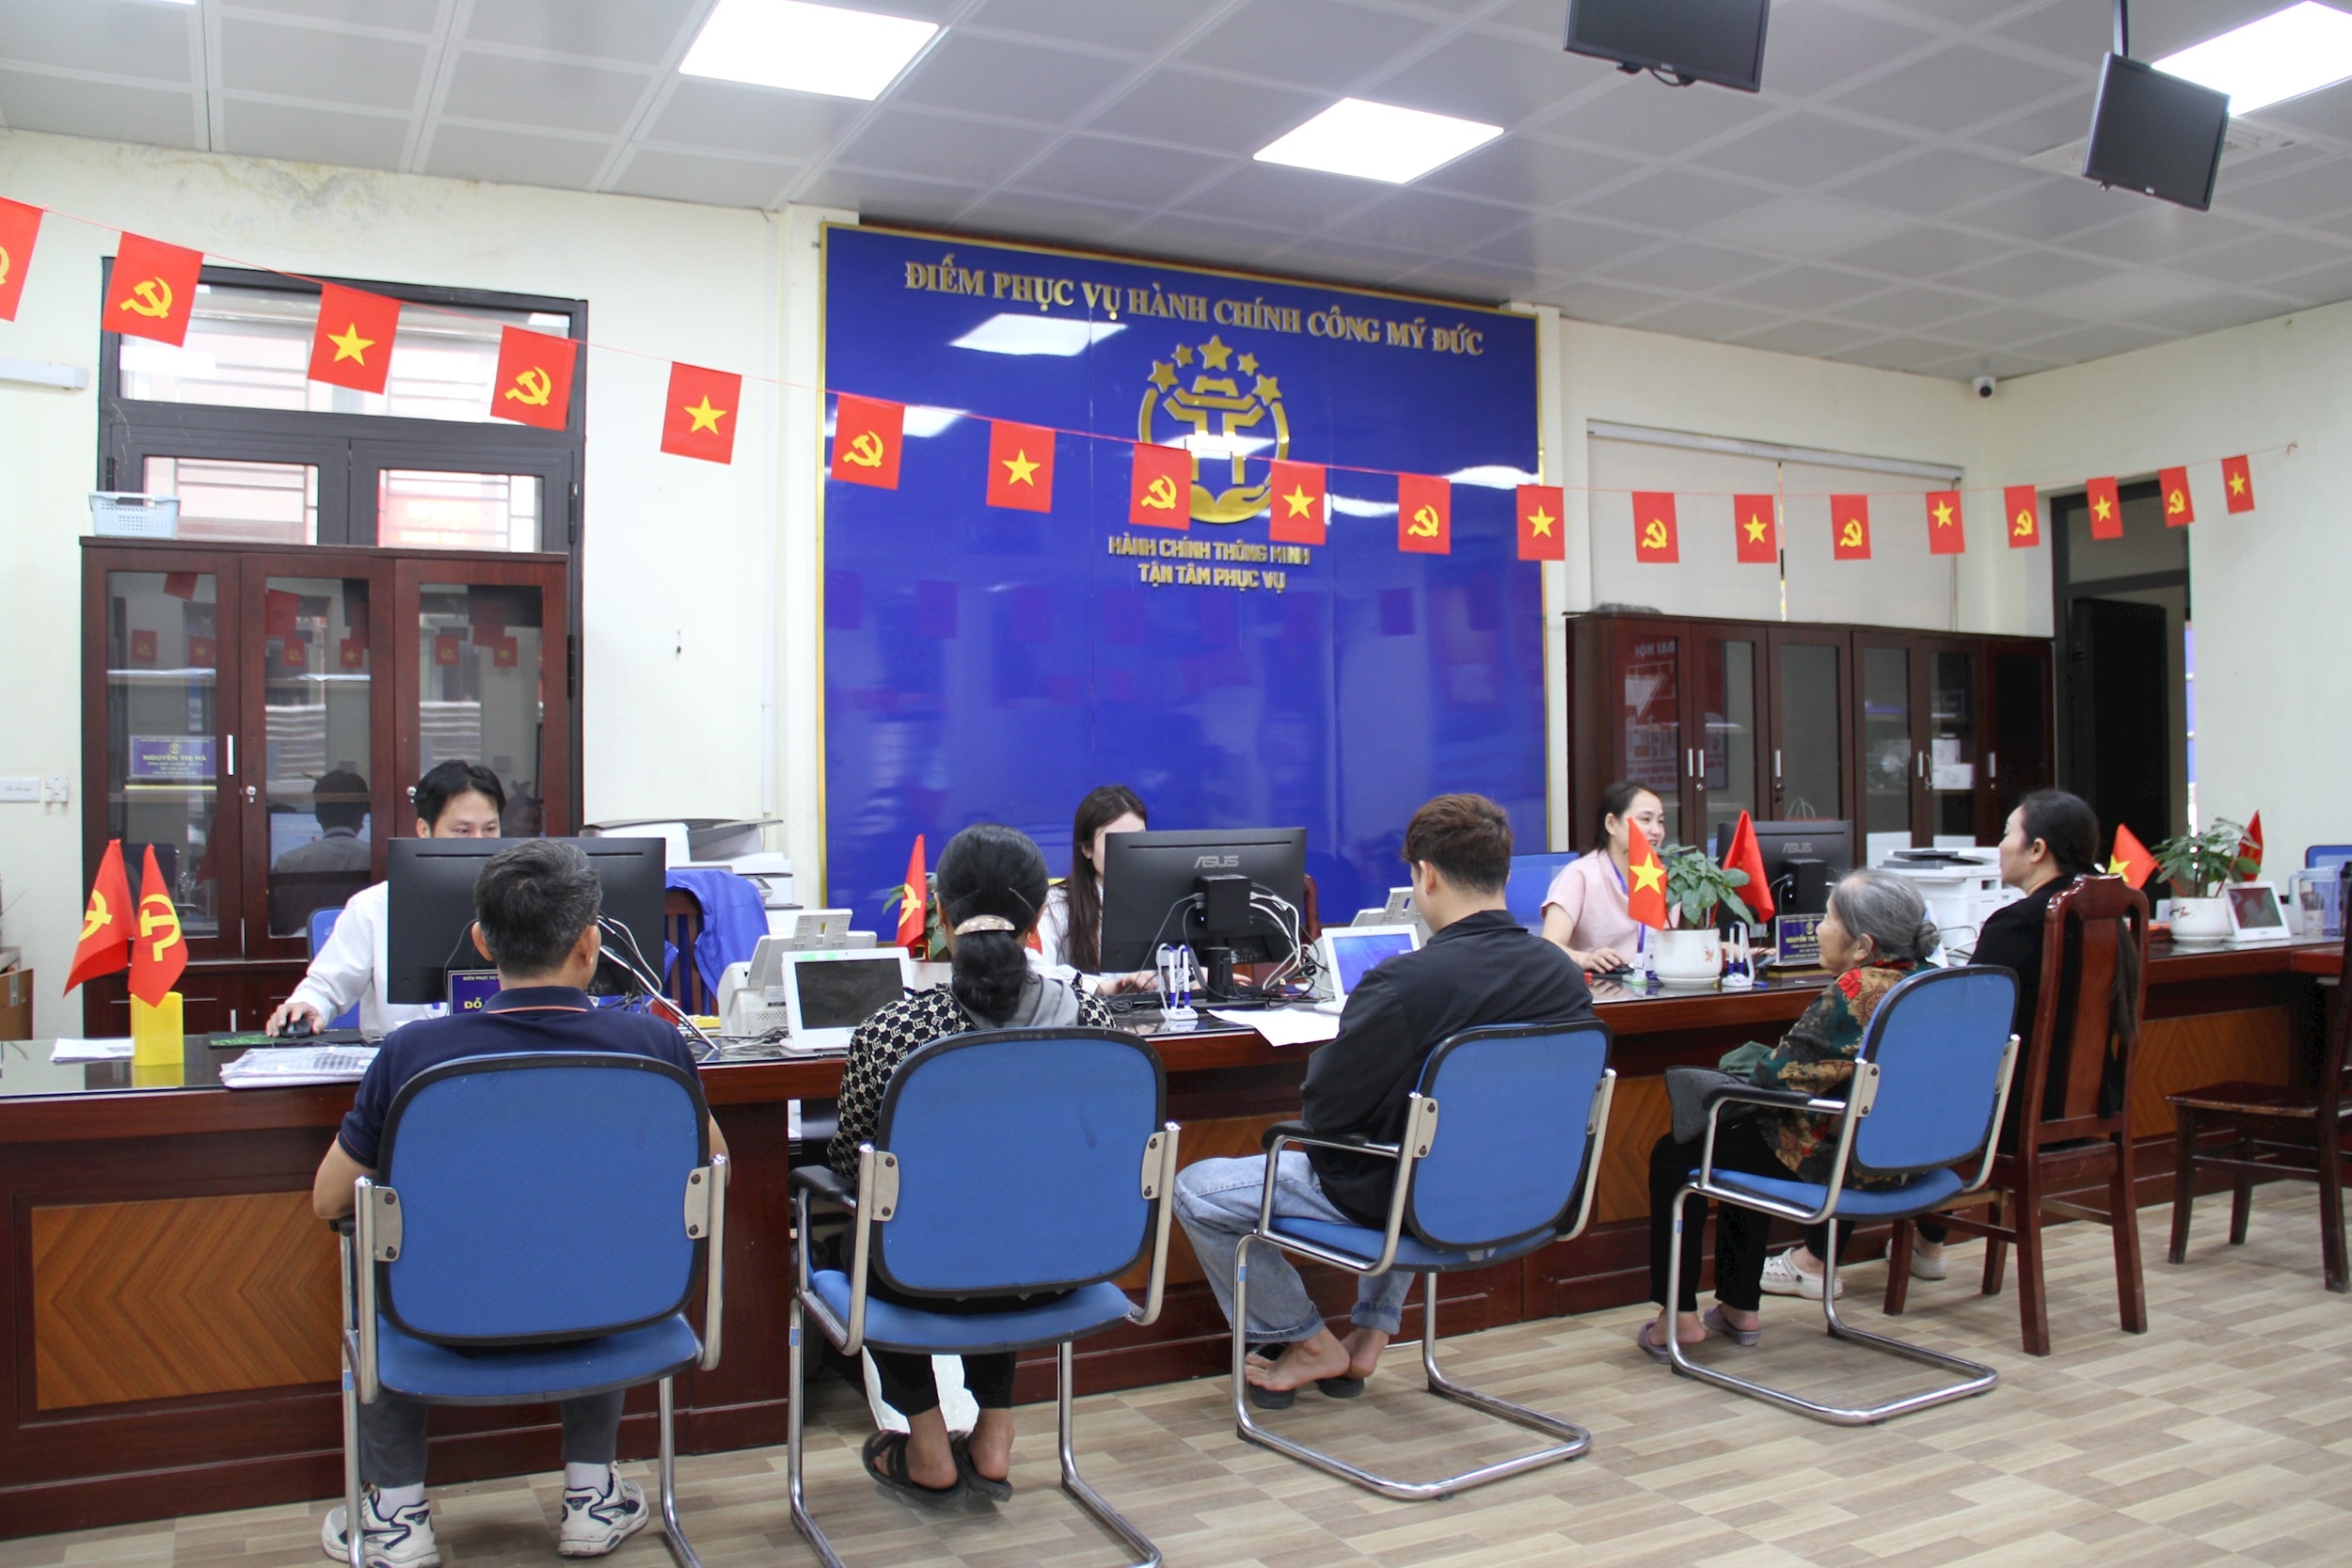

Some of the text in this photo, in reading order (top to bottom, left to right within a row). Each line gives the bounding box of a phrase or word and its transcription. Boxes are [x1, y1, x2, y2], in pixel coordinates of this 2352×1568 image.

[904, 254, 1485, 356] ĐIỂM PHỤC VỤ HÀNH CHÍNH CÔNG MỸ ĐỨC
[1108, 531, 1311, 564] HÀNH CHÍNH THÔNG MINH
[1137, 561, 1286, 594] TẬN TÂM PHỤC VỤ
[1194, 855, 1239, 868] ASUS
[1782, 843, 1812, 853] ASUS
